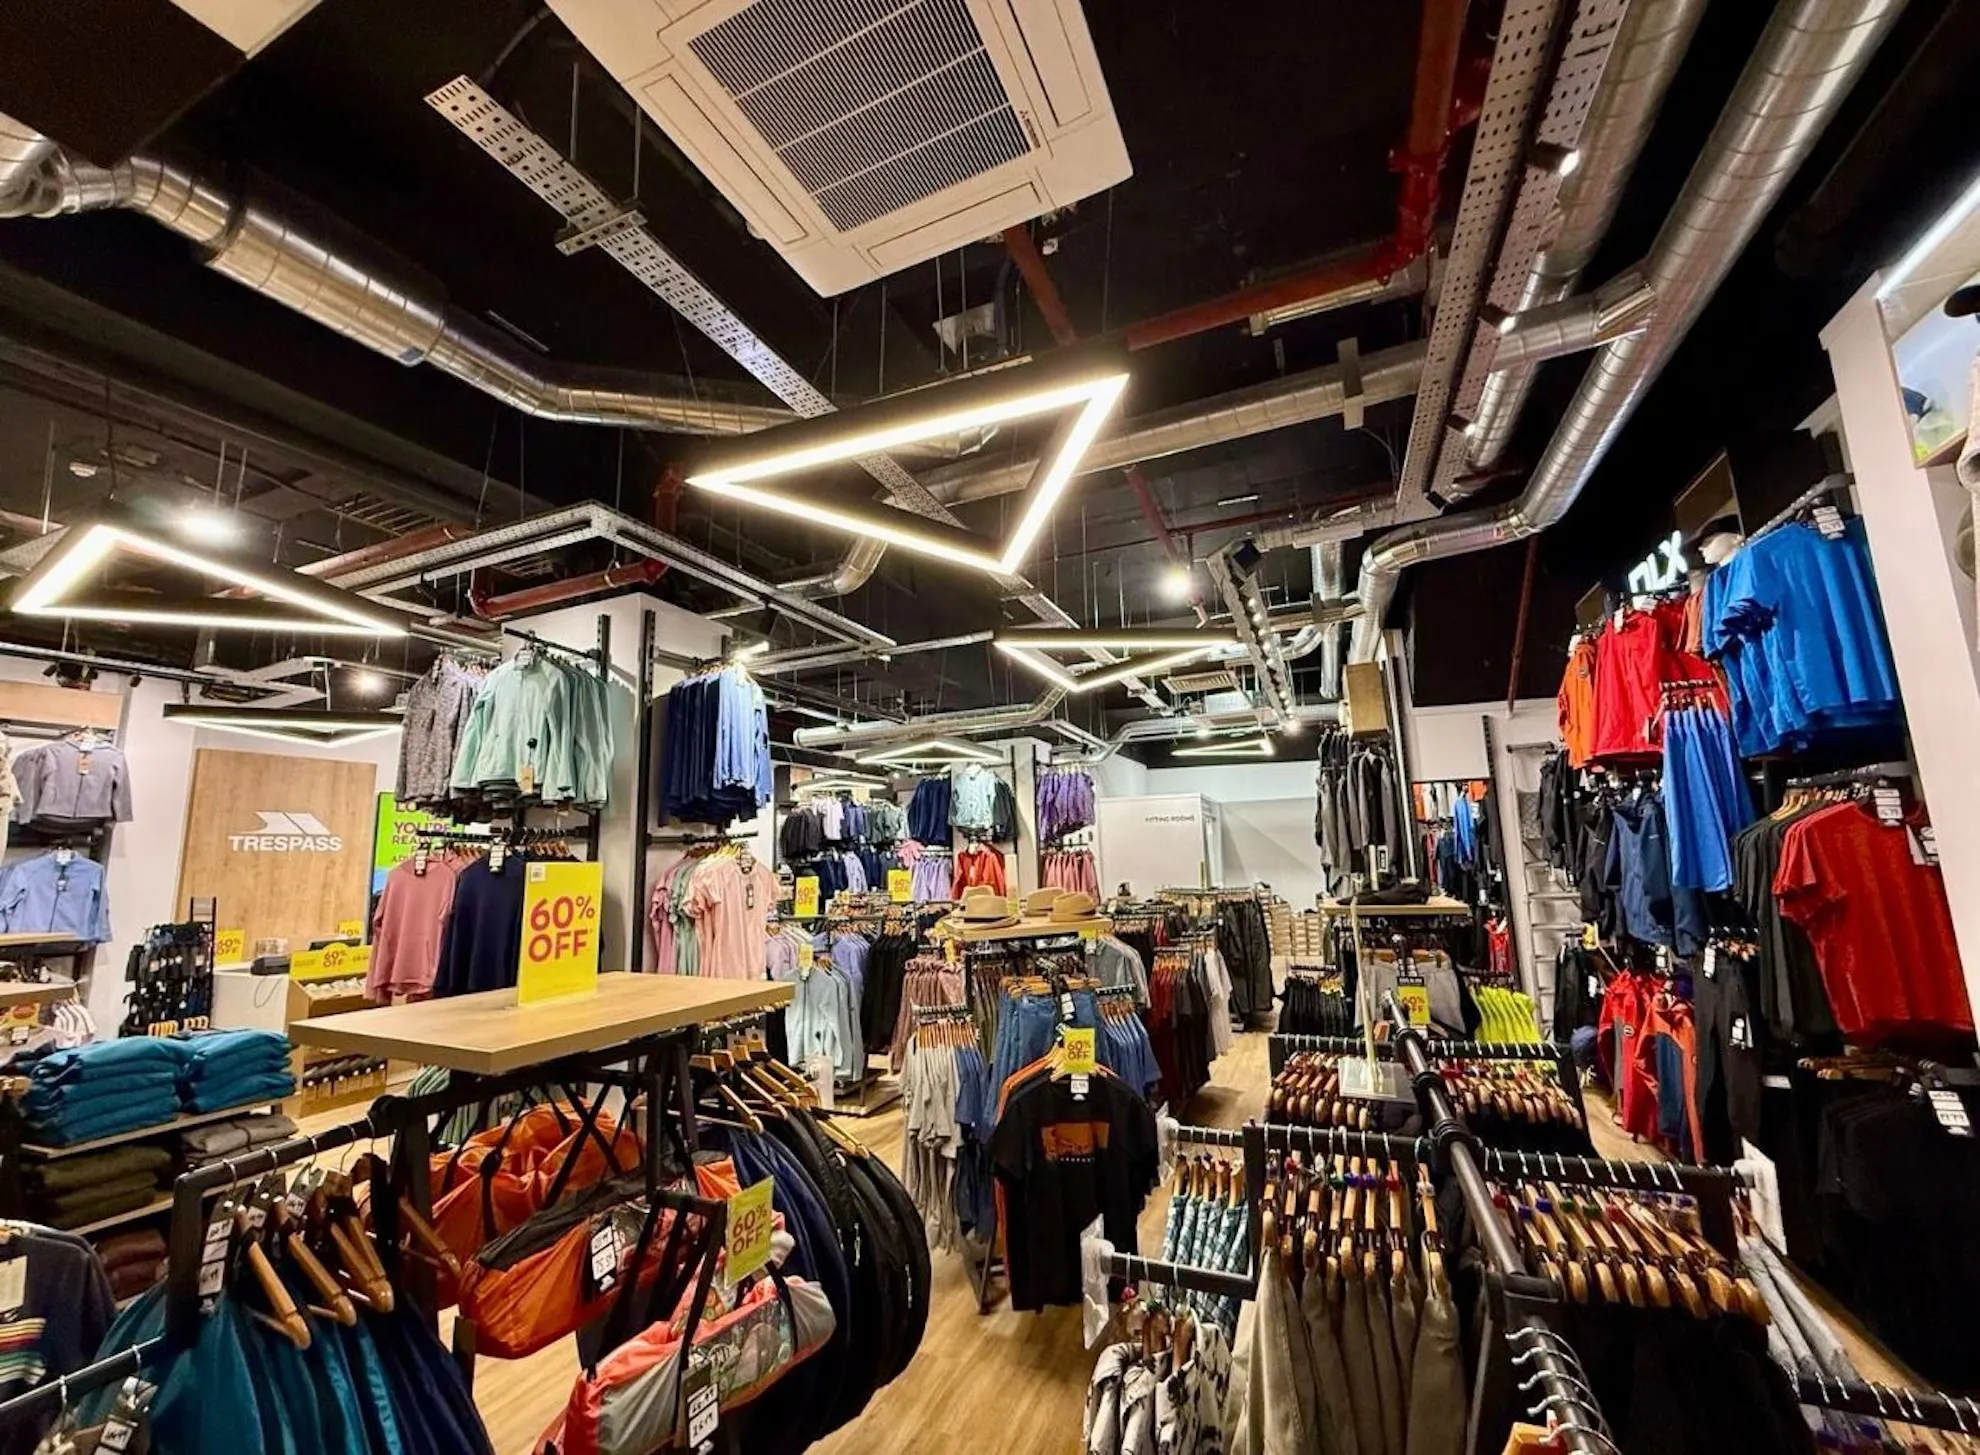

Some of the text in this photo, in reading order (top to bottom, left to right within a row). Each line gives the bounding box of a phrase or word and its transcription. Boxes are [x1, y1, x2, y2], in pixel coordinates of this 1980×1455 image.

[228, 835, 343, 852] TRESPASS
[530, 896, 596, 932] 60%
[217, 938, 242, 948] 60%
[528, 929, 589, 963] OFF
[215, 947, 239, 957] OFF
[324, 950, 348, 960] 60%
[323, 958, 344, 968] OFF
[1067, 1040, 1091, 1051] 60%
[1068, 1050, 1091, 1061] OFF
[733, 1202, 769, 1239] 60%
[732, 1223, 764, 1256] OFF
